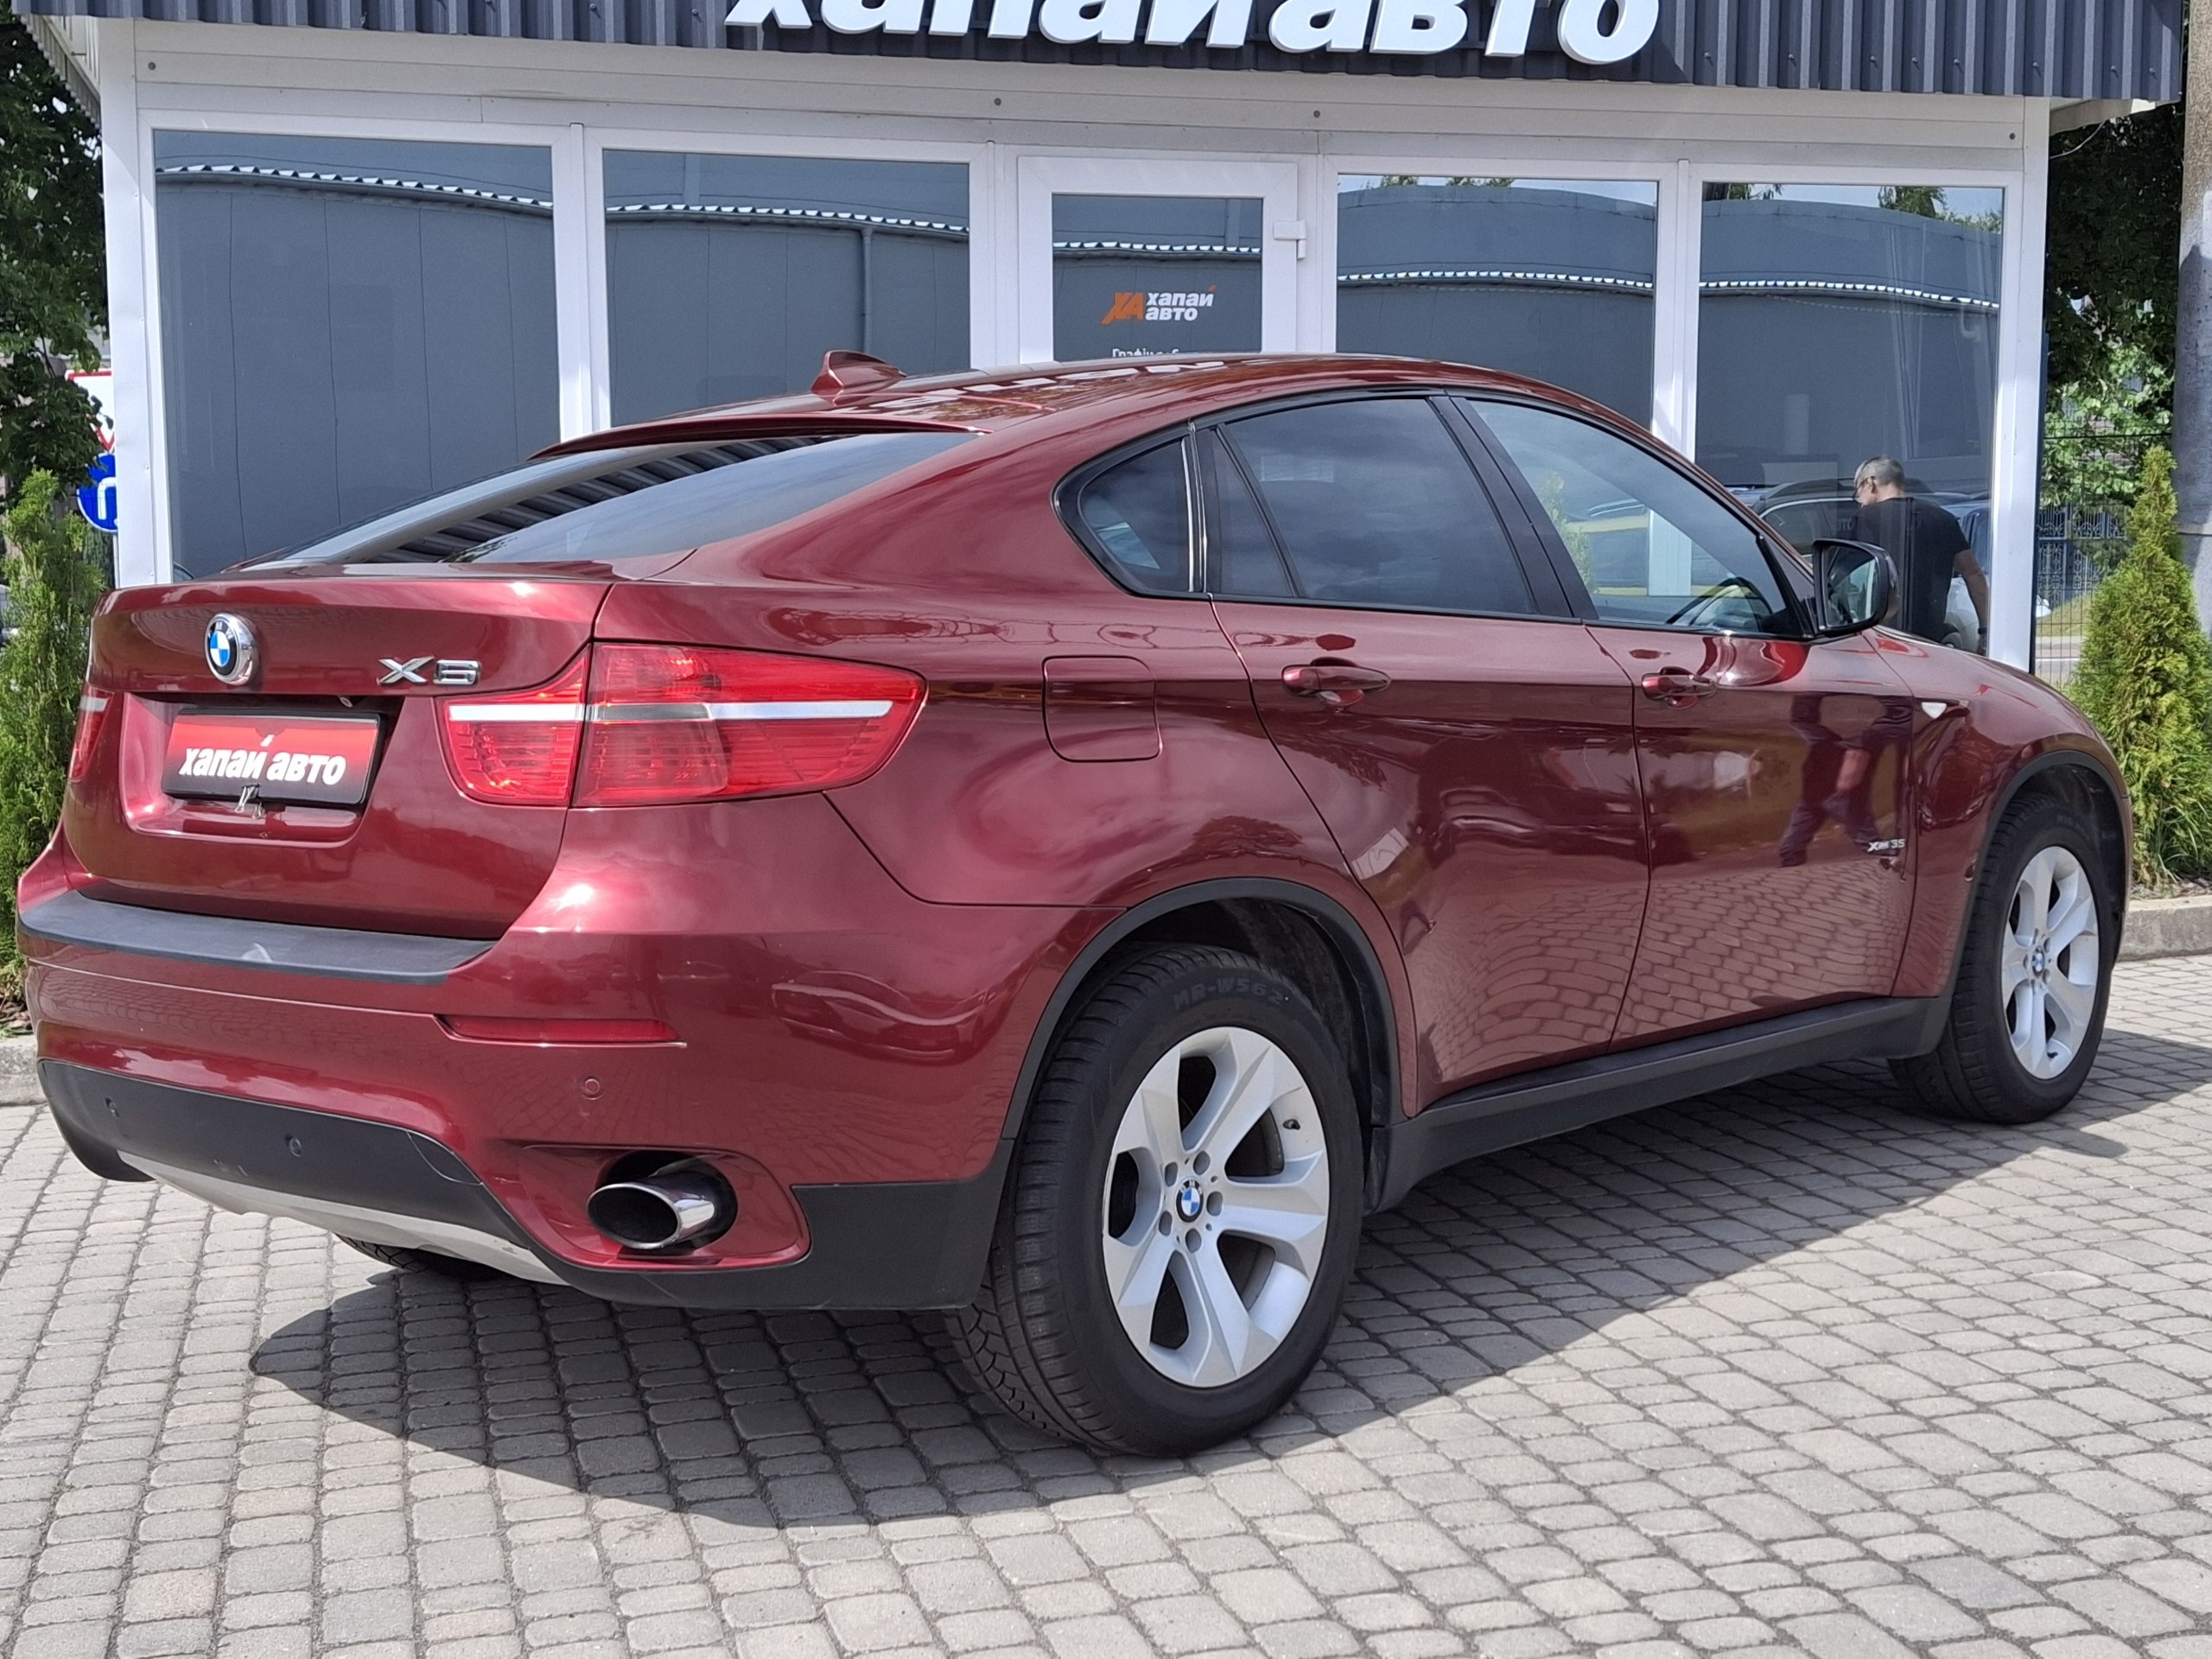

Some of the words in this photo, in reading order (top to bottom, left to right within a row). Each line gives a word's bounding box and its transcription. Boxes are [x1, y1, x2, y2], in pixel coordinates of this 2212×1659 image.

[1145, 285, 1217, 308] хапай
[1145, 307, 1198, 321] авто
[377, 654, 483, 686] X6
[179, 734, 275, 780] хапай
[266, 751, 346, 785] авто
